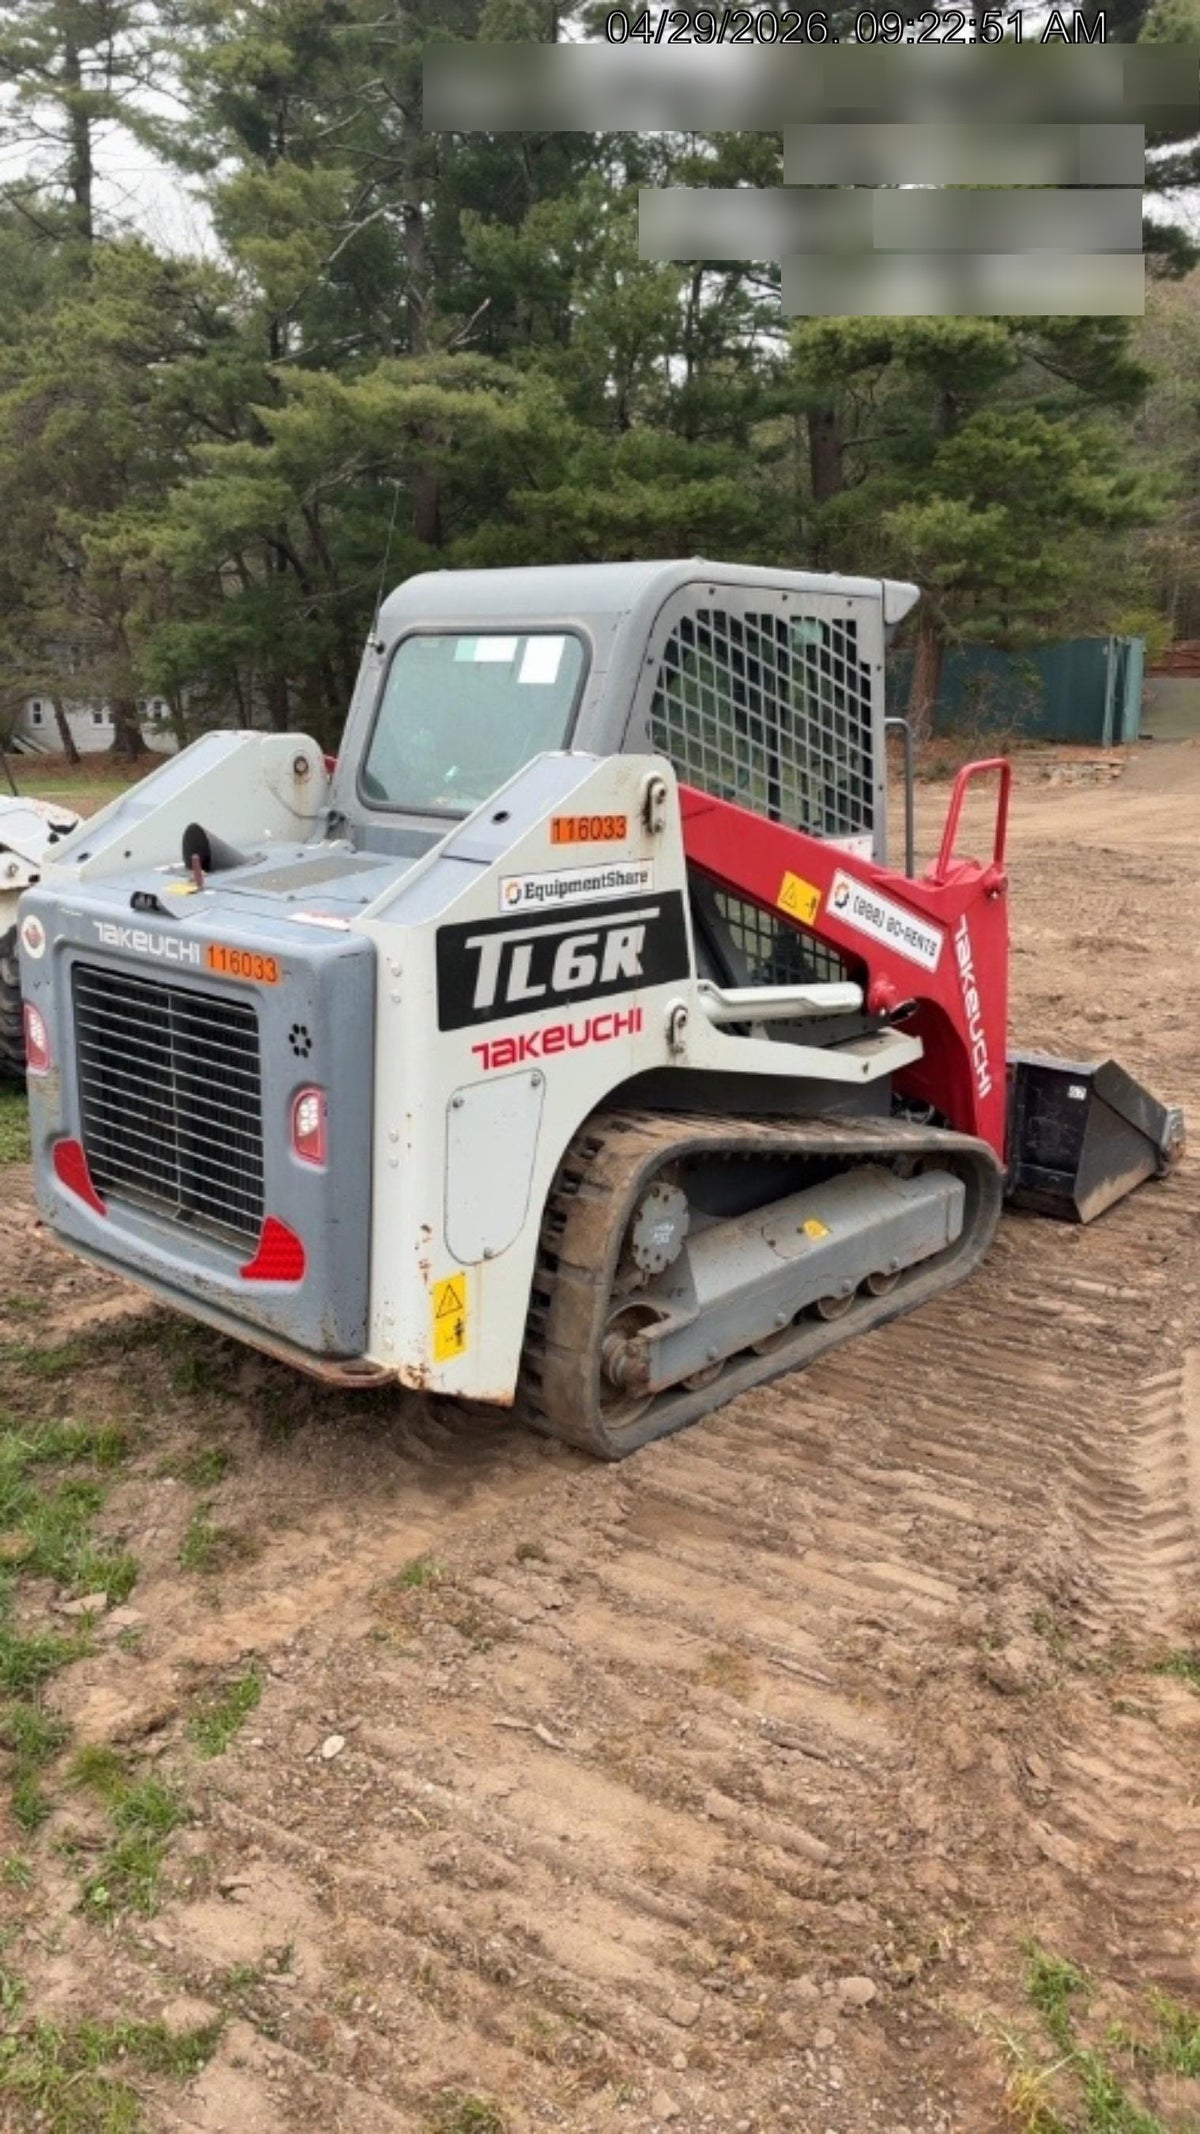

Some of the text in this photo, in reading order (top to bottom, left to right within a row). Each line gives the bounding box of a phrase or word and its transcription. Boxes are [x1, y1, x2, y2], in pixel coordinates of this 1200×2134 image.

[552, 816, 626, 840] 116033
[524, 871, 648, 899] EquipmentShare
[207, 945, 278, 983] 116033
[465, 907, 660, 1009] TL6R
